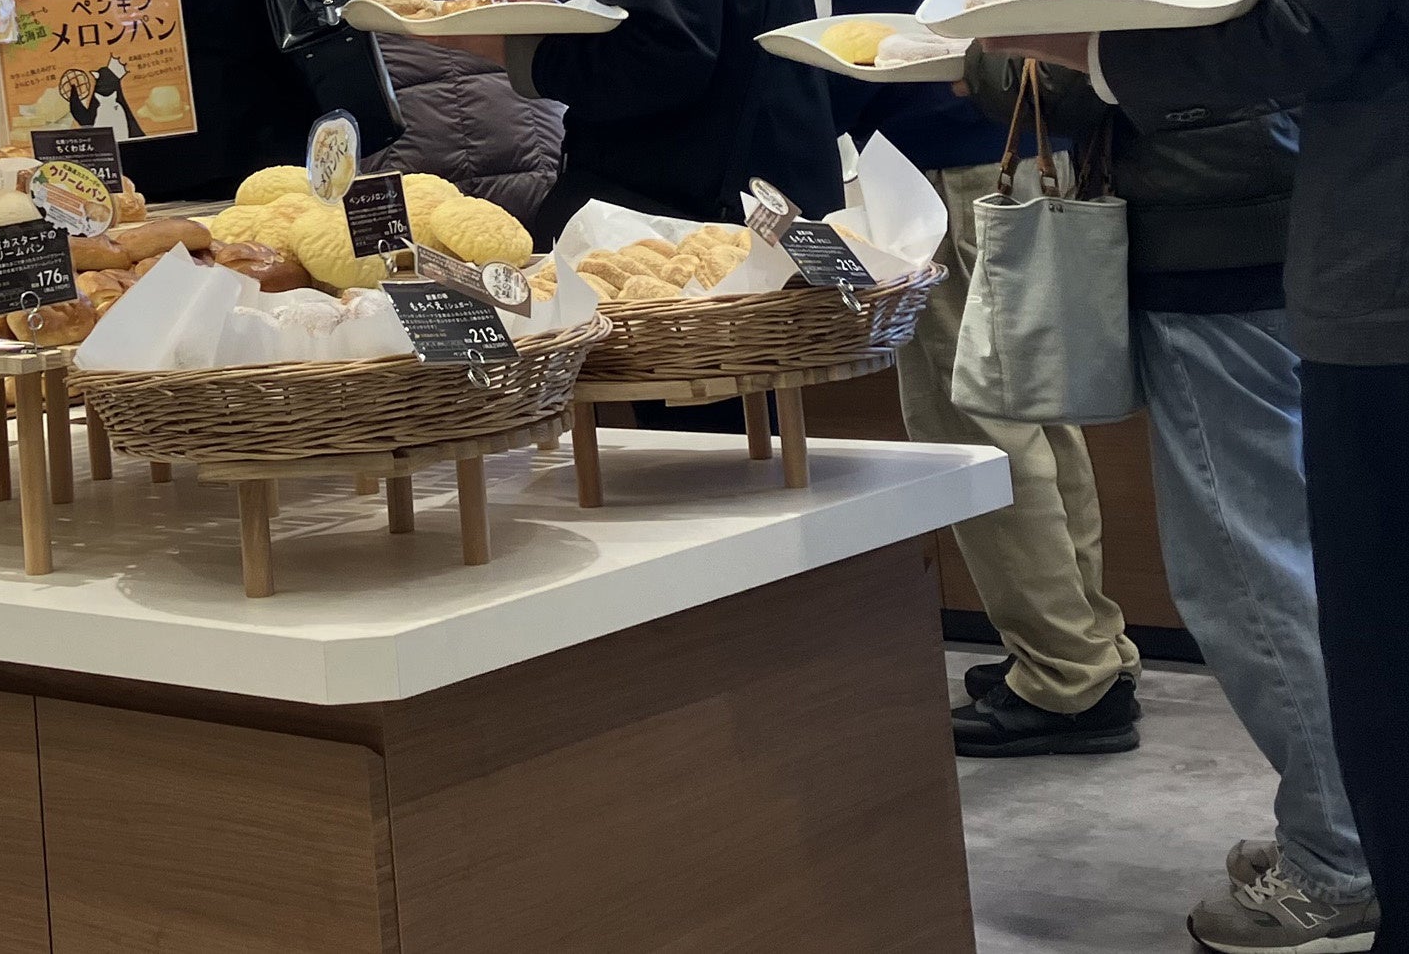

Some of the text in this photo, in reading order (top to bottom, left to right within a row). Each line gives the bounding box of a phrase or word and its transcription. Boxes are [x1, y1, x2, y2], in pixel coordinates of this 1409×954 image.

[50, 15, 176, 52] メロンパン
[50, 165, 106, 202] クリームパン
